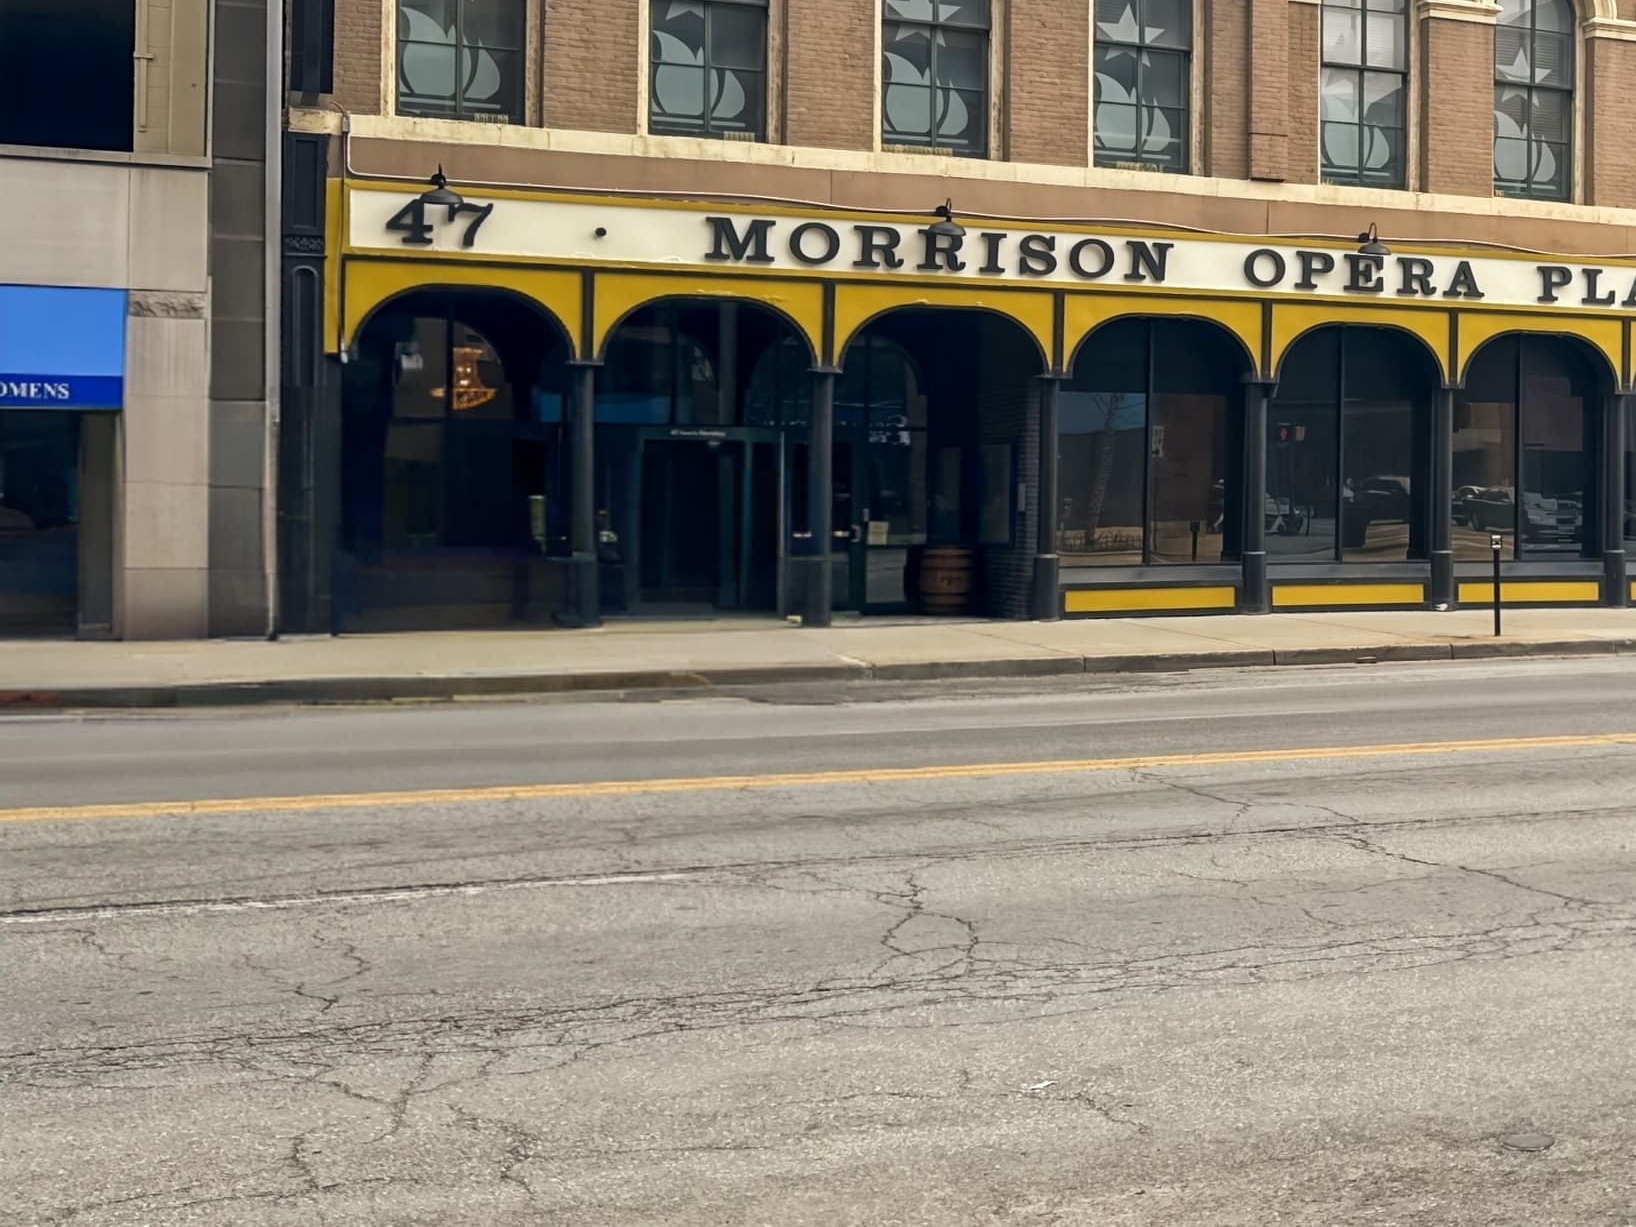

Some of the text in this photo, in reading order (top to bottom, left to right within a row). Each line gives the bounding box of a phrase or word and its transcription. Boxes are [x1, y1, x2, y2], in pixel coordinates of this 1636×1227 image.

[386, 199, 494, 247] 47
[705, 216, 1174, 281] MORRISON
[1244, 249, 1485, 298] OPERA
